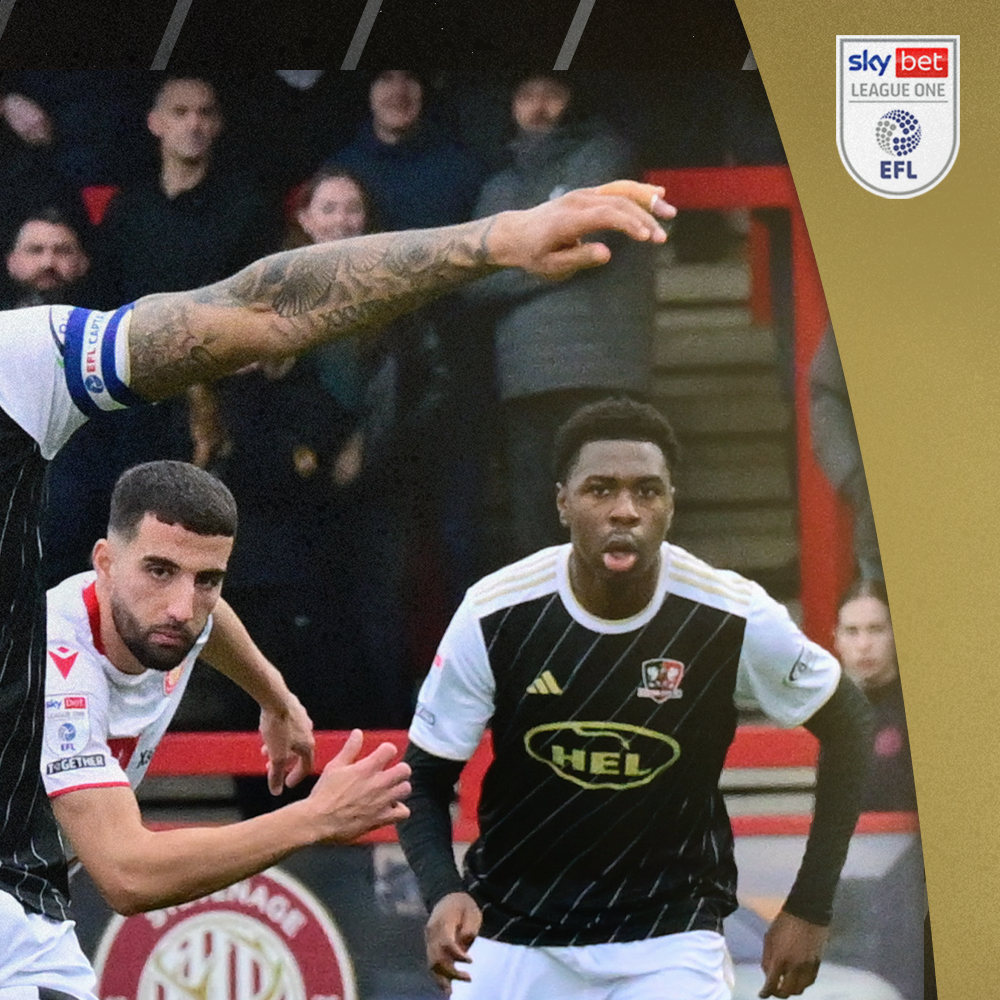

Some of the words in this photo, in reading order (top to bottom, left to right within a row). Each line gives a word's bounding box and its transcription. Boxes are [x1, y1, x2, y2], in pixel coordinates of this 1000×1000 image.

[86, 348, 97, 373] EFL
[47, 755, 105, 774] TOGETHER
[551, 745, 652, 776] HEL
